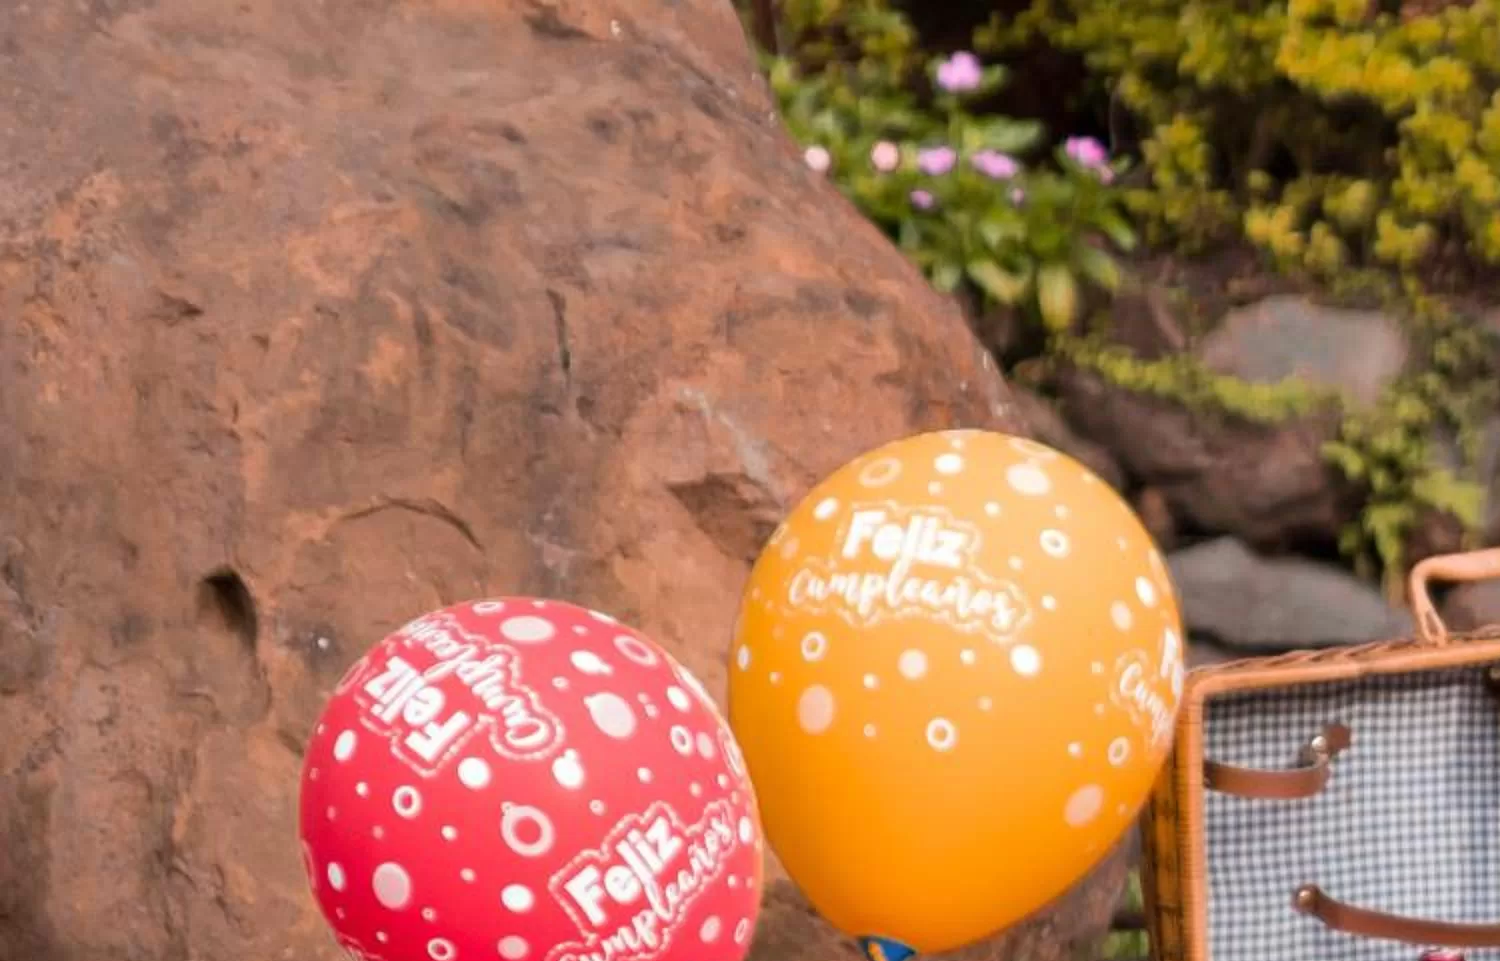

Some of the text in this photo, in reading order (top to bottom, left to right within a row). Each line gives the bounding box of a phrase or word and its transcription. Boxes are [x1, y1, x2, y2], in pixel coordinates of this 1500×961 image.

[842, 510, 965, 568] Feliz
[364, 655, 470, 762] Feliz
[564, 816, 682, 926] Feliz
